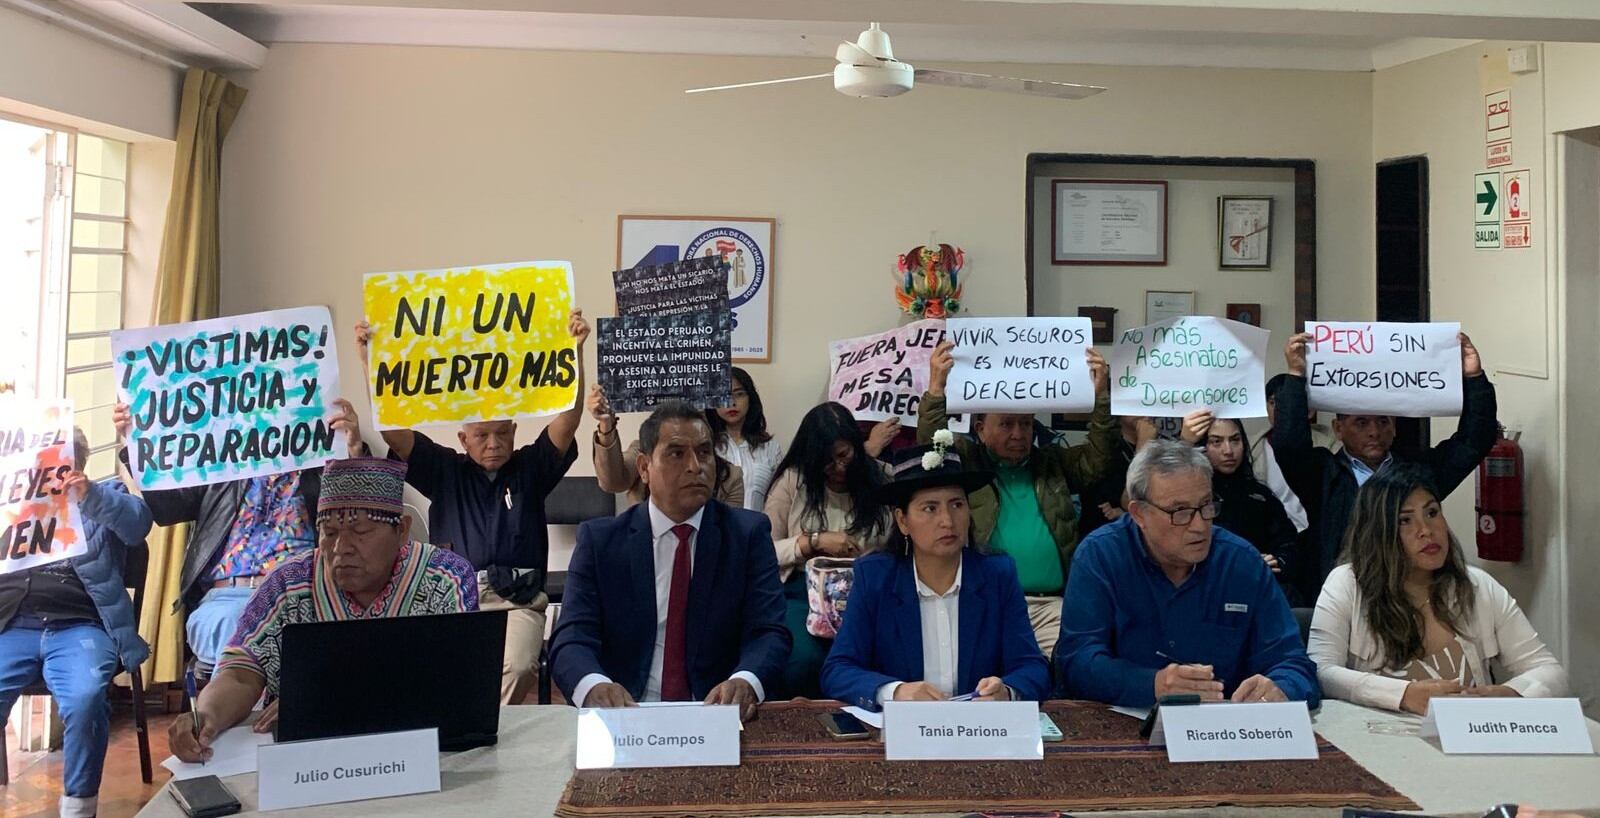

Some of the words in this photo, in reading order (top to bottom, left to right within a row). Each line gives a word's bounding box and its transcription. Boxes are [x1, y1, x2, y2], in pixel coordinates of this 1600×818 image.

[694, 230, 728, 247] NACIONAL
[1475, 230, 1499, 242] SALIDA
[739, 235, 762, 265] DERECHOS
[631, 280, 641, 288] NO
[688, 268, 714, 277] SICARIO
[743, 266, 763, 299] HUMANOS
[635, 287, 649, 295] NOS
[657, 300, 674, 308] PARA
[688, 294, 718, 303] VÍCTIMAS
[394, 296, 446, 339] NI
[473, 292, 536, 334] UN
[615, 329, 625, 338] EL
[628, 328, 666, 337] ESTADO
[668, 326, 713, 336] PERUANO
[1006, 326, 1085, 344] SEGUROS
[1153, 319, 1202, 346] más
[1313, 325, 1375, 355] PERÚ
[1389, 333, 1426, 353] SIN
[612, 341, 661, 350] INCENTIVA
[664, 340, 674, 348] EL
[677, 338, 714, 348] CRIMEN,
[603, 354, 654, 364] PROMUEVE
[657, 353, 668, 361] LA
[671, 351, 725, 361] IMPUNIDAD
[835, 336, 897, 375] FUERA
[974, 355, 992, 370] ES
[1136, 343, 1238, 369] Asesinatos
[376, 352, 509, 397] MUERTO
[519, 348, 576, 389] MAS
[609, 368, 616, 377] Y
[619, 366, 657, 376] ASESINA
[659, 366, 666, 374] A
[669, 364, 709, 374] QUIENES
[711, 363, 721, 372] LE
[1119, 365, 1137, 388] de
[626, 379, 659, 389] EXIGEN
[662, 377, 704, 387] JUSTICIA.
[839, 367, 913, 399] MESA
[963, 380, 1071, 401] DERECHO
[135, 371, 286, 431] JUSTICIA
[29, 429, 65, 448] DEL
[137, 419, 335, 473] REPARACION
[1485, 520, 1491, 530] 2
[918, 725, 954, 737] Tania
[957, 725, 1008, 737] Pariona
[1186, 729, 1237, 741] Ricardo
[1239, 727, 1293, 740] Soberón
[1468, 722, 1508, 733] Judith
[1509, 722, 1558, 733] Pancca
[647, 734, 705, 748] Campos
[293, 769, 329, 785] Julio
[333, 760, 406, 780] Cusurichi
